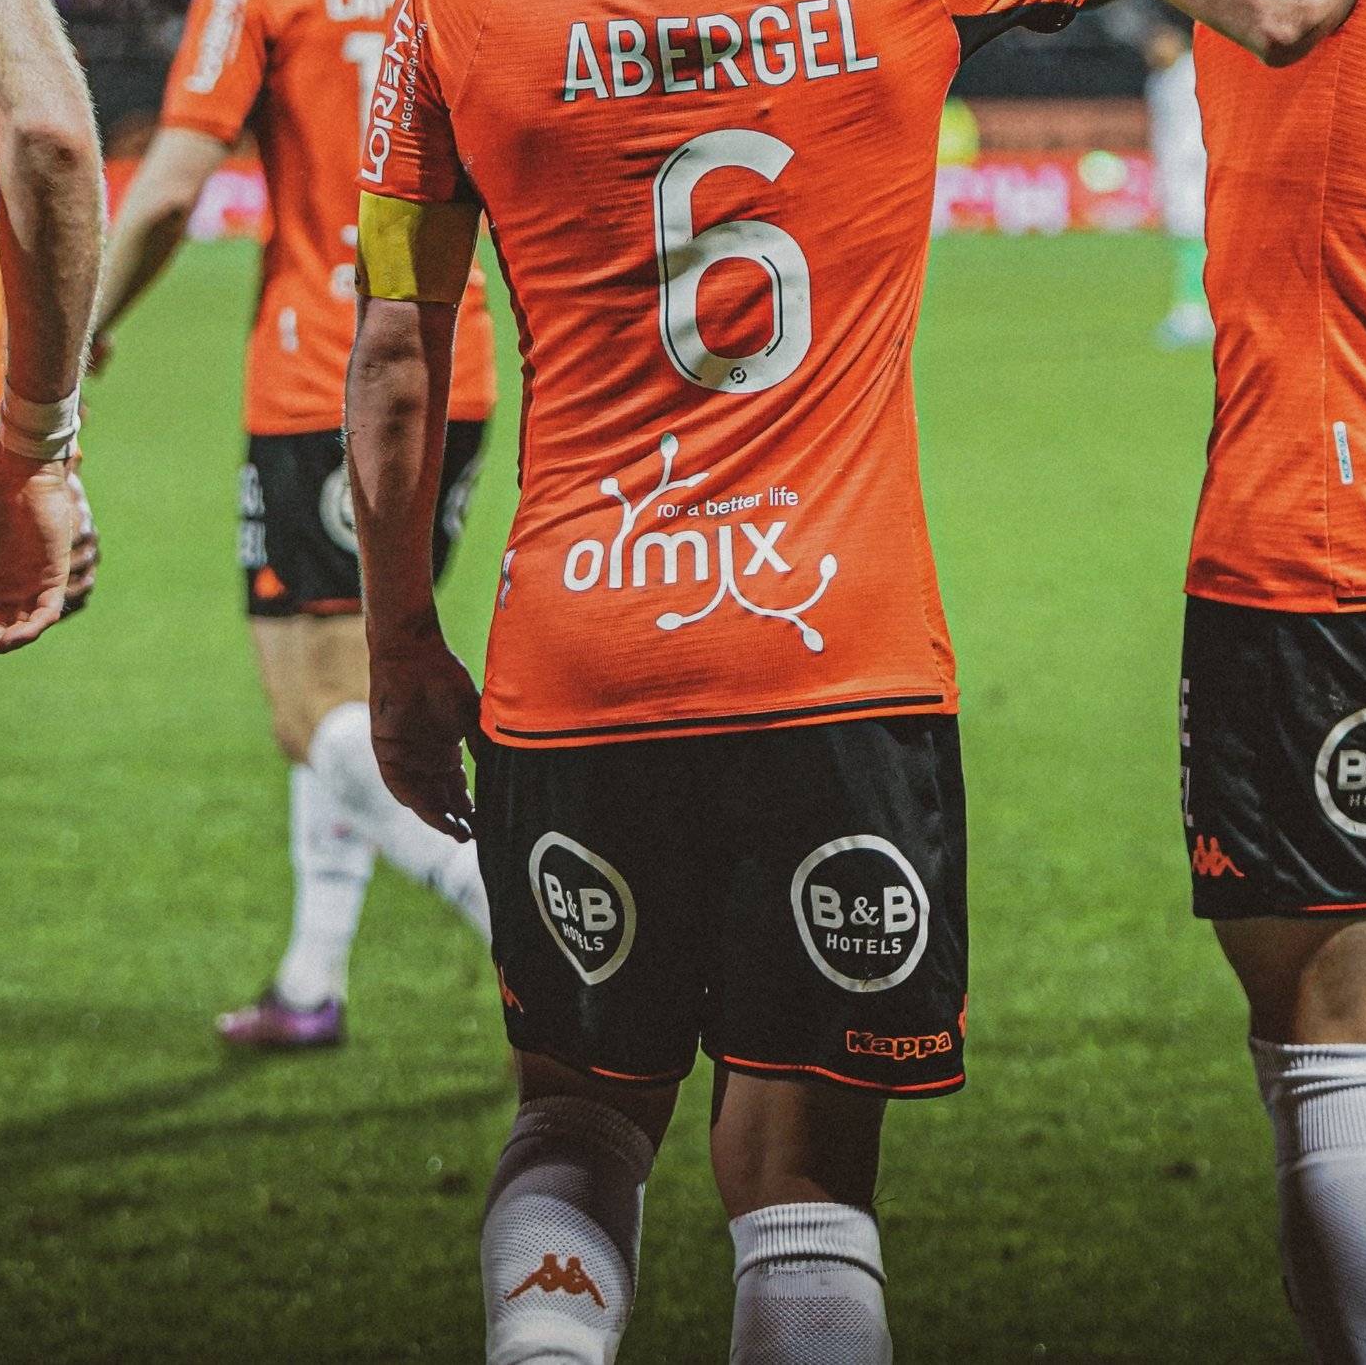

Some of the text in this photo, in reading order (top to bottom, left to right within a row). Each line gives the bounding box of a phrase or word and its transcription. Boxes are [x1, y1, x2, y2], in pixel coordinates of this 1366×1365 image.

[653, 128, 812, 394] 6
[688, 504, 700, 516] a
[706, 494, 763, 515] better
[769, 486, 799, 506] life
[544, 873, 617, 932] B&B
[810, 885, 916, 934] B&B
[563, 923, 604, 951] HOTELS
[826, 933, 902, 955] HOTELS
[846, 1031, 952, 1060] Kappa
